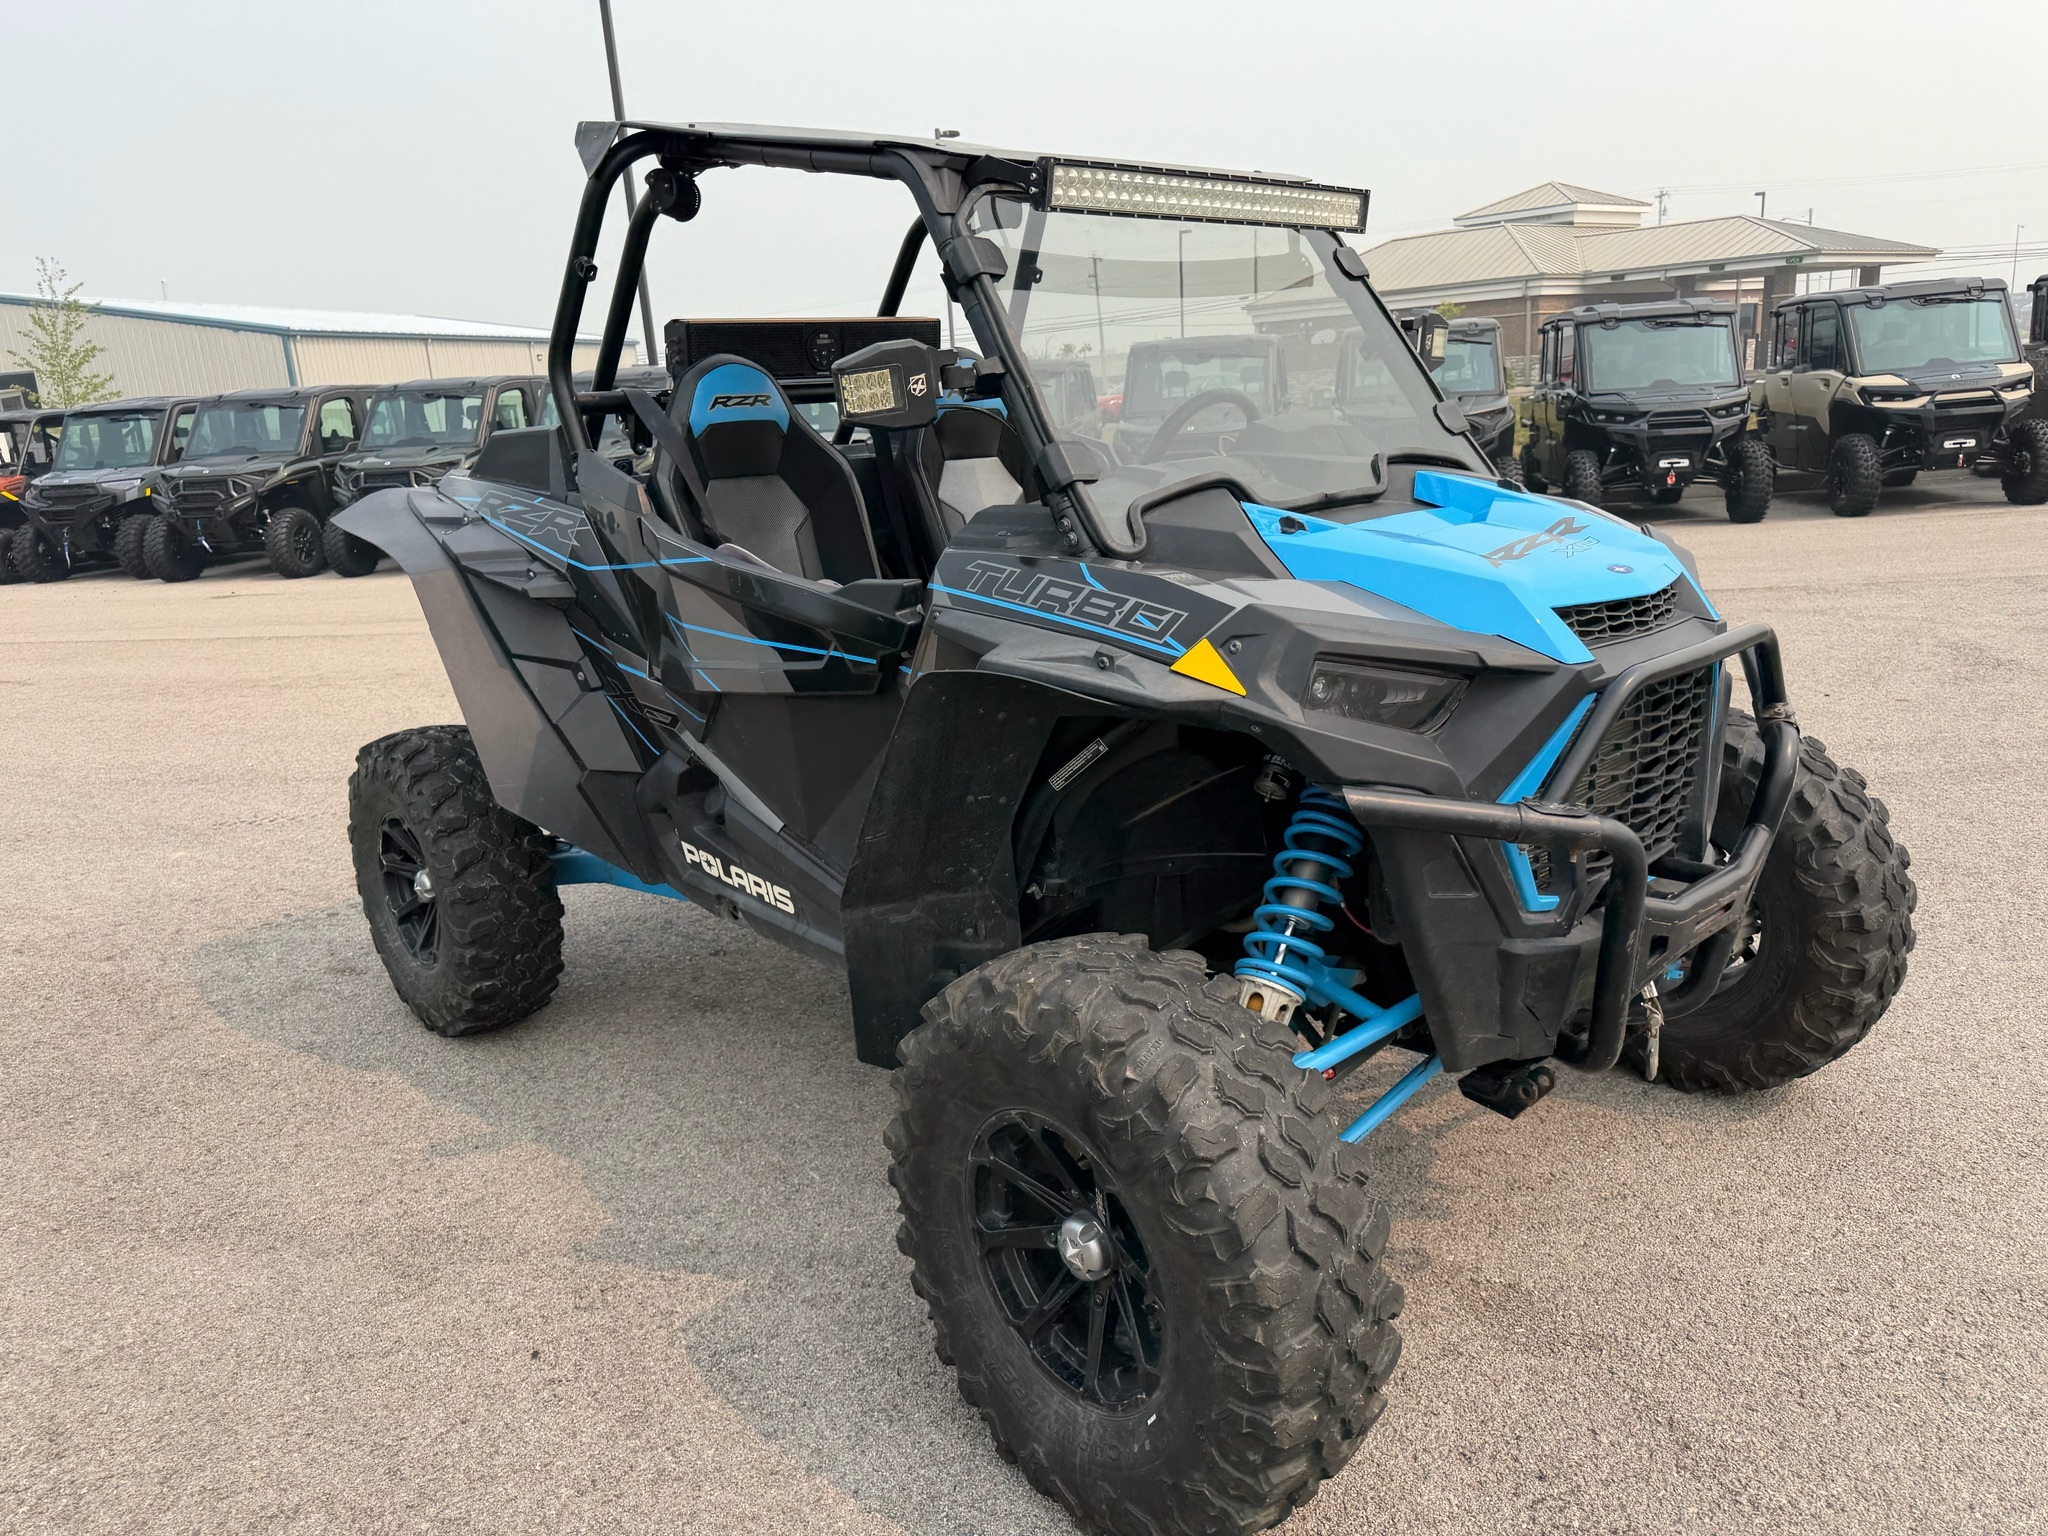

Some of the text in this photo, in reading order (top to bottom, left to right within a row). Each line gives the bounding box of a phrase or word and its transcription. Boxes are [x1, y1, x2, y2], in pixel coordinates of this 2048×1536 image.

[709, 394, 772, 411] RZR
[475, 490, 582, 547] RZR
[1479, 517, 1591, 569] RZR
[1551, 536, 1600, 559] XP
[965, 559, 1190, 644] TURBO
[680, 840, 796, 915] POLARIS
